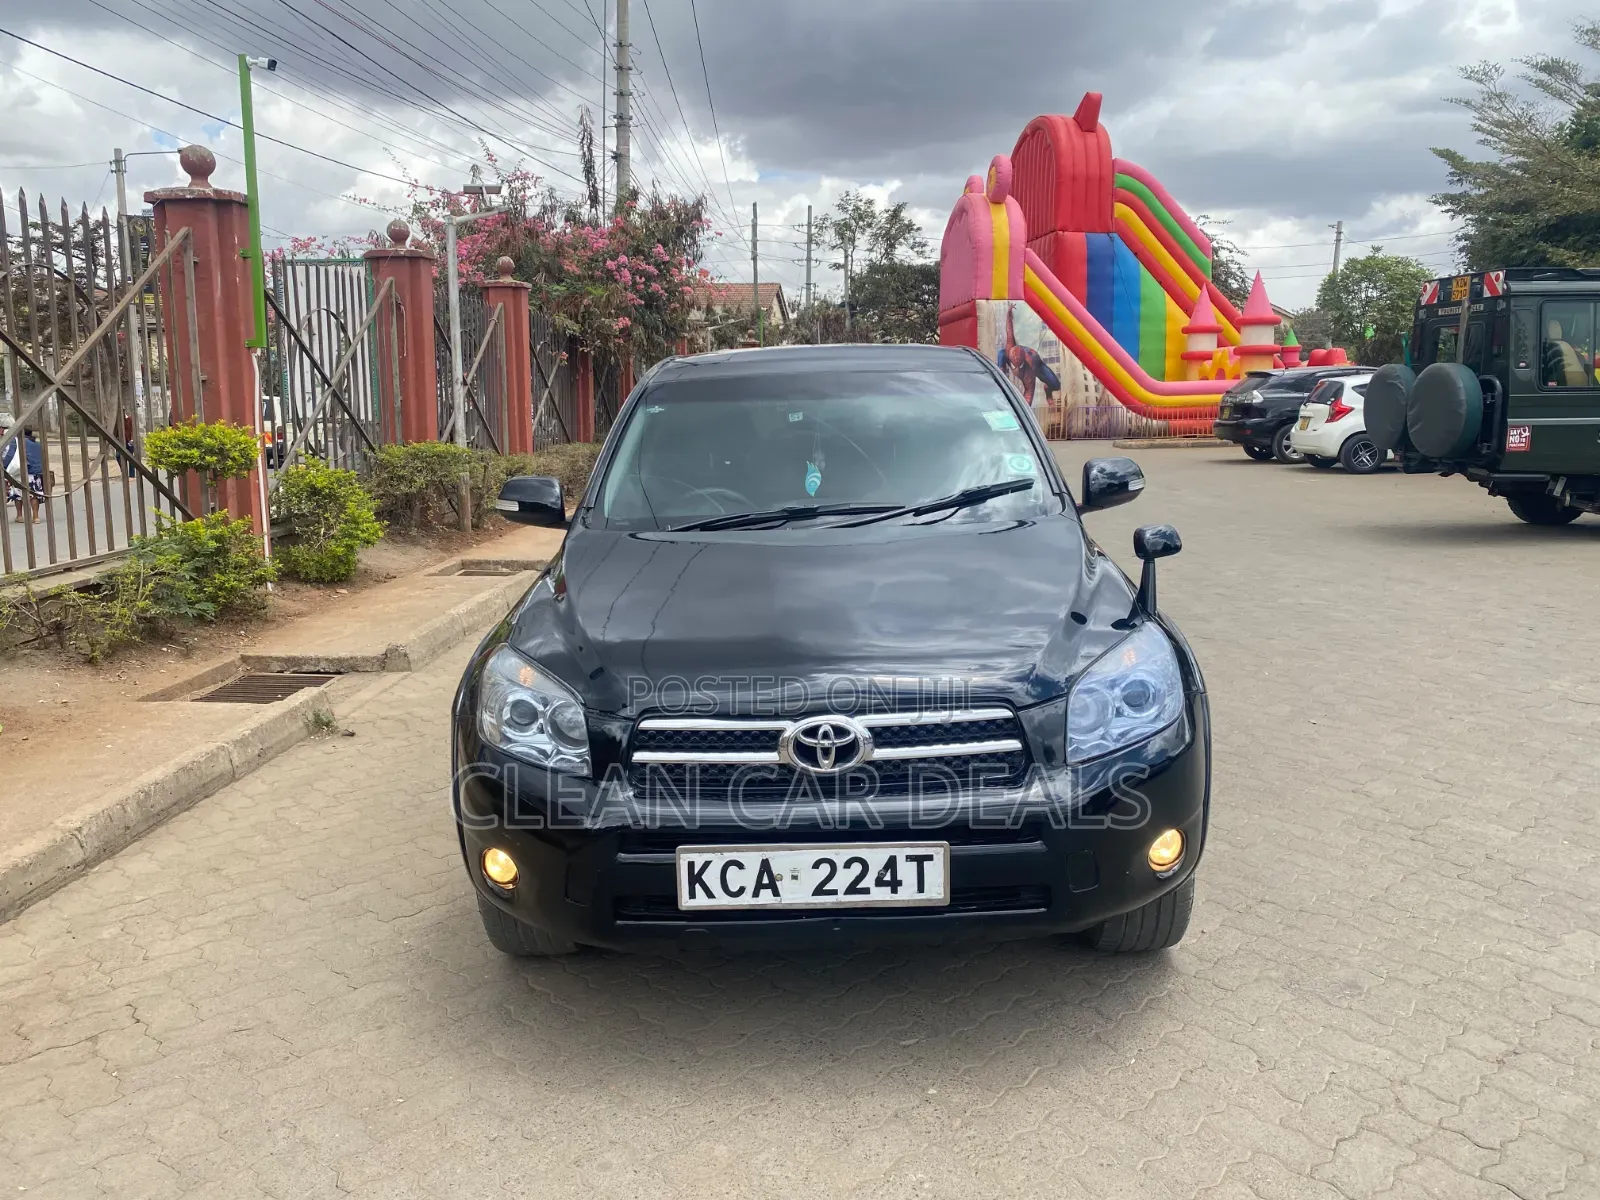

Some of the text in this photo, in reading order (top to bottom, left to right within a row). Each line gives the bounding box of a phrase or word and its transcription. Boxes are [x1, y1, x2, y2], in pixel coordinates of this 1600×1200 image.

[1509, 435, 1520, 443] NO
[687, 854, 934, 900] KCA 224T
